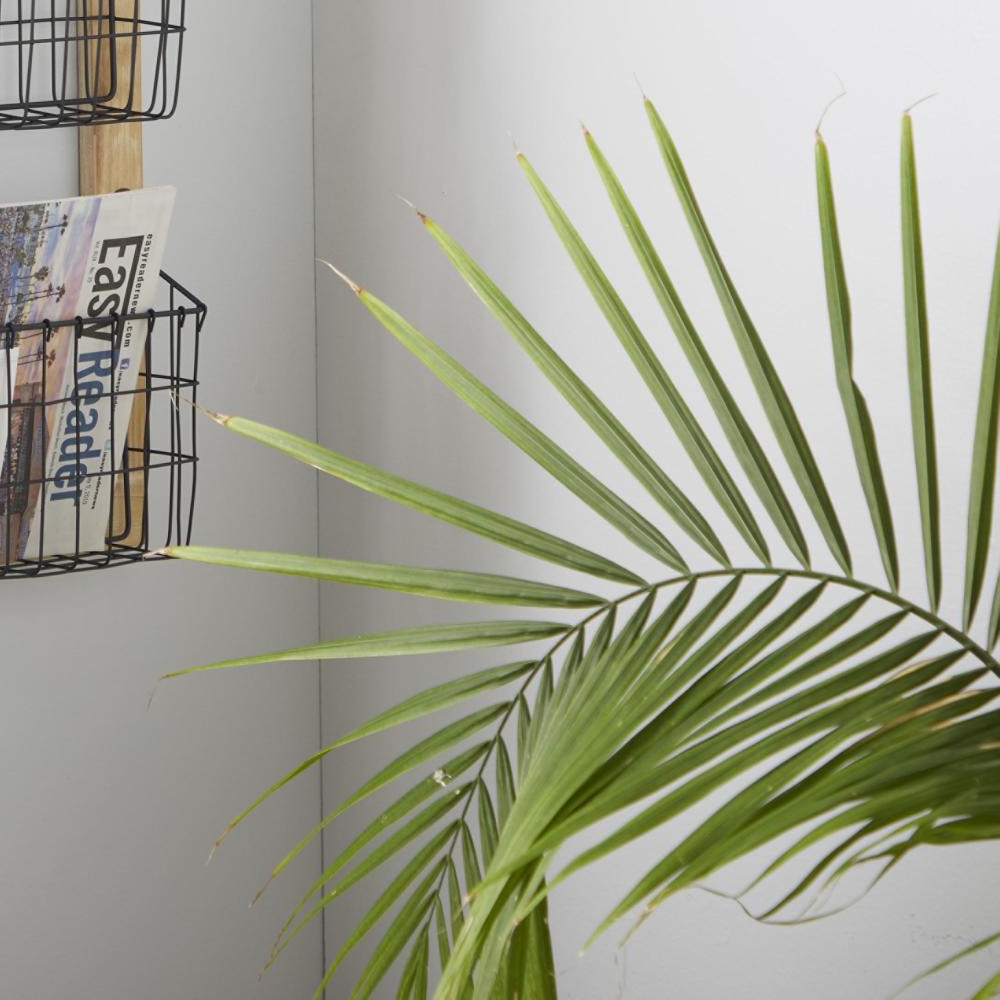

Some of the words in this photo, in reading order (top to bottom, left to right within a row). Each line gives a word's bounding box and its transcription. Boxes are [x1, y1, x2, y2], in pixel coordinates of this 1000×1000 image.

[79, 235, 144, 349] Easy
[124, 233, 153, 347] easyreadernew.com
[50, 349, 120, 507] Reader
